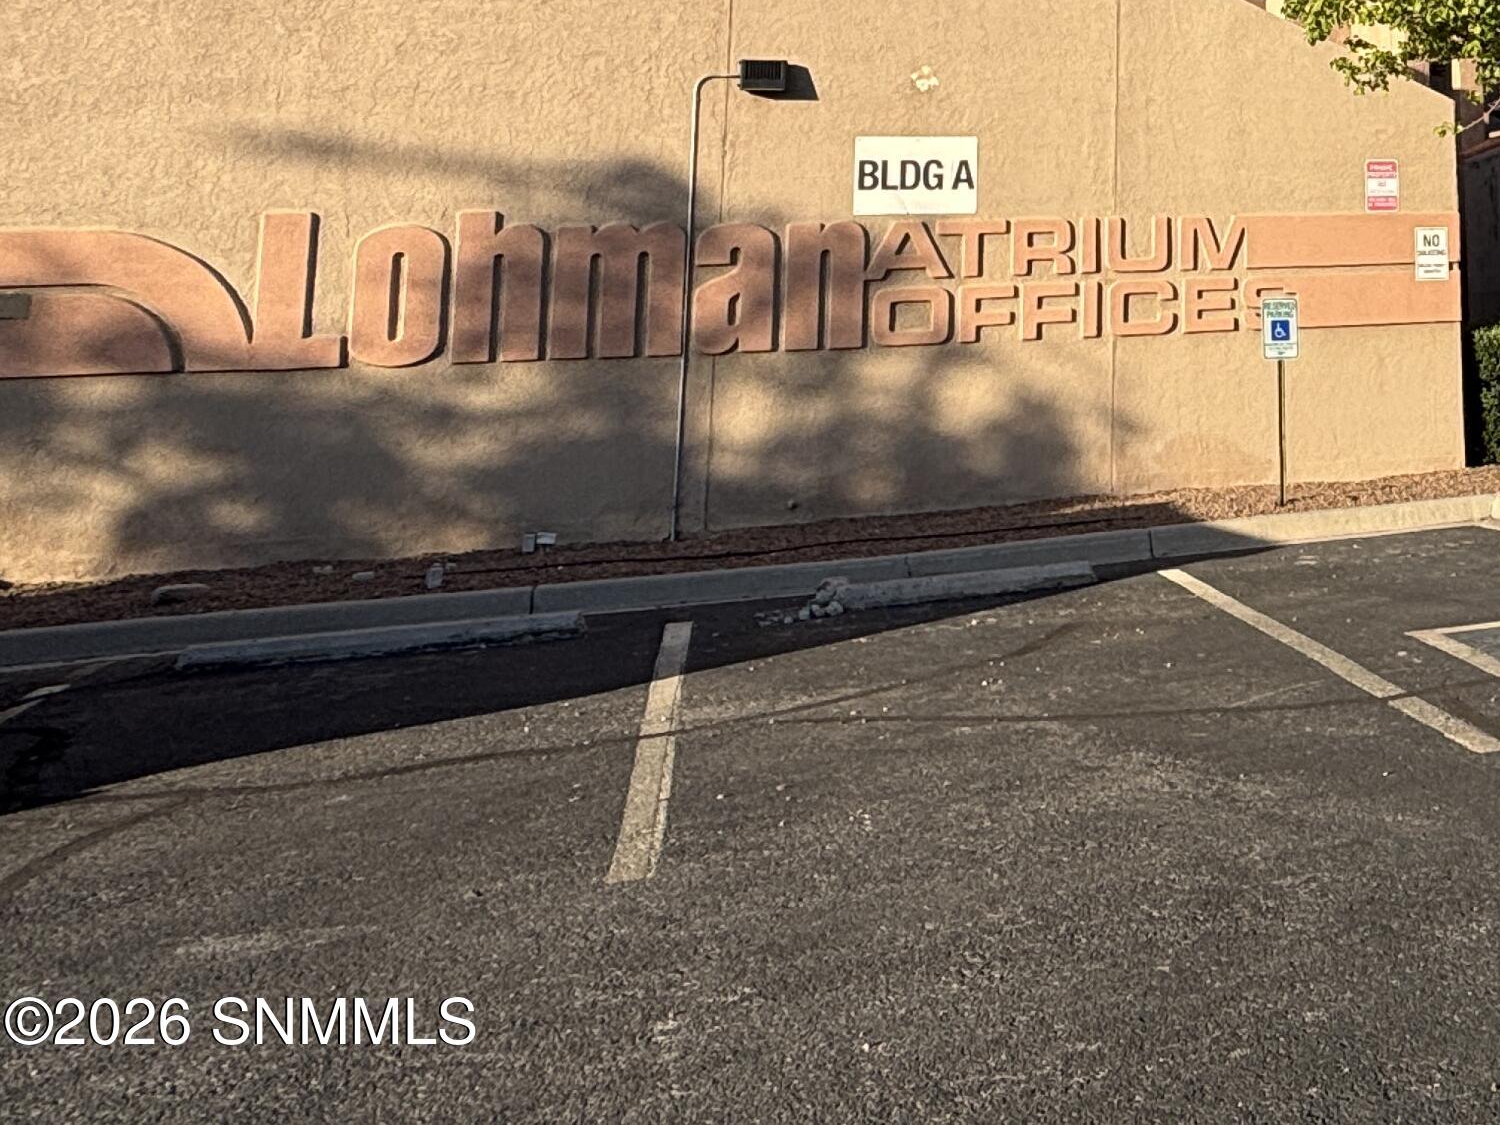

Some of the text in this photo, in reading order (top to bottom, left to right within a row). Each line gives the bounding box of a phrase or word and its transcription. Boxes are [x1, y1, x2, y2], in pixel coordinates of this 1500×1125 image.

[857, 159, 975, 191] BLDG A
[865, 215, 1248, 282] ATRIUM
[1422, 234, 1441, 248] NO
[255, 209, 872, 371] Lohman
